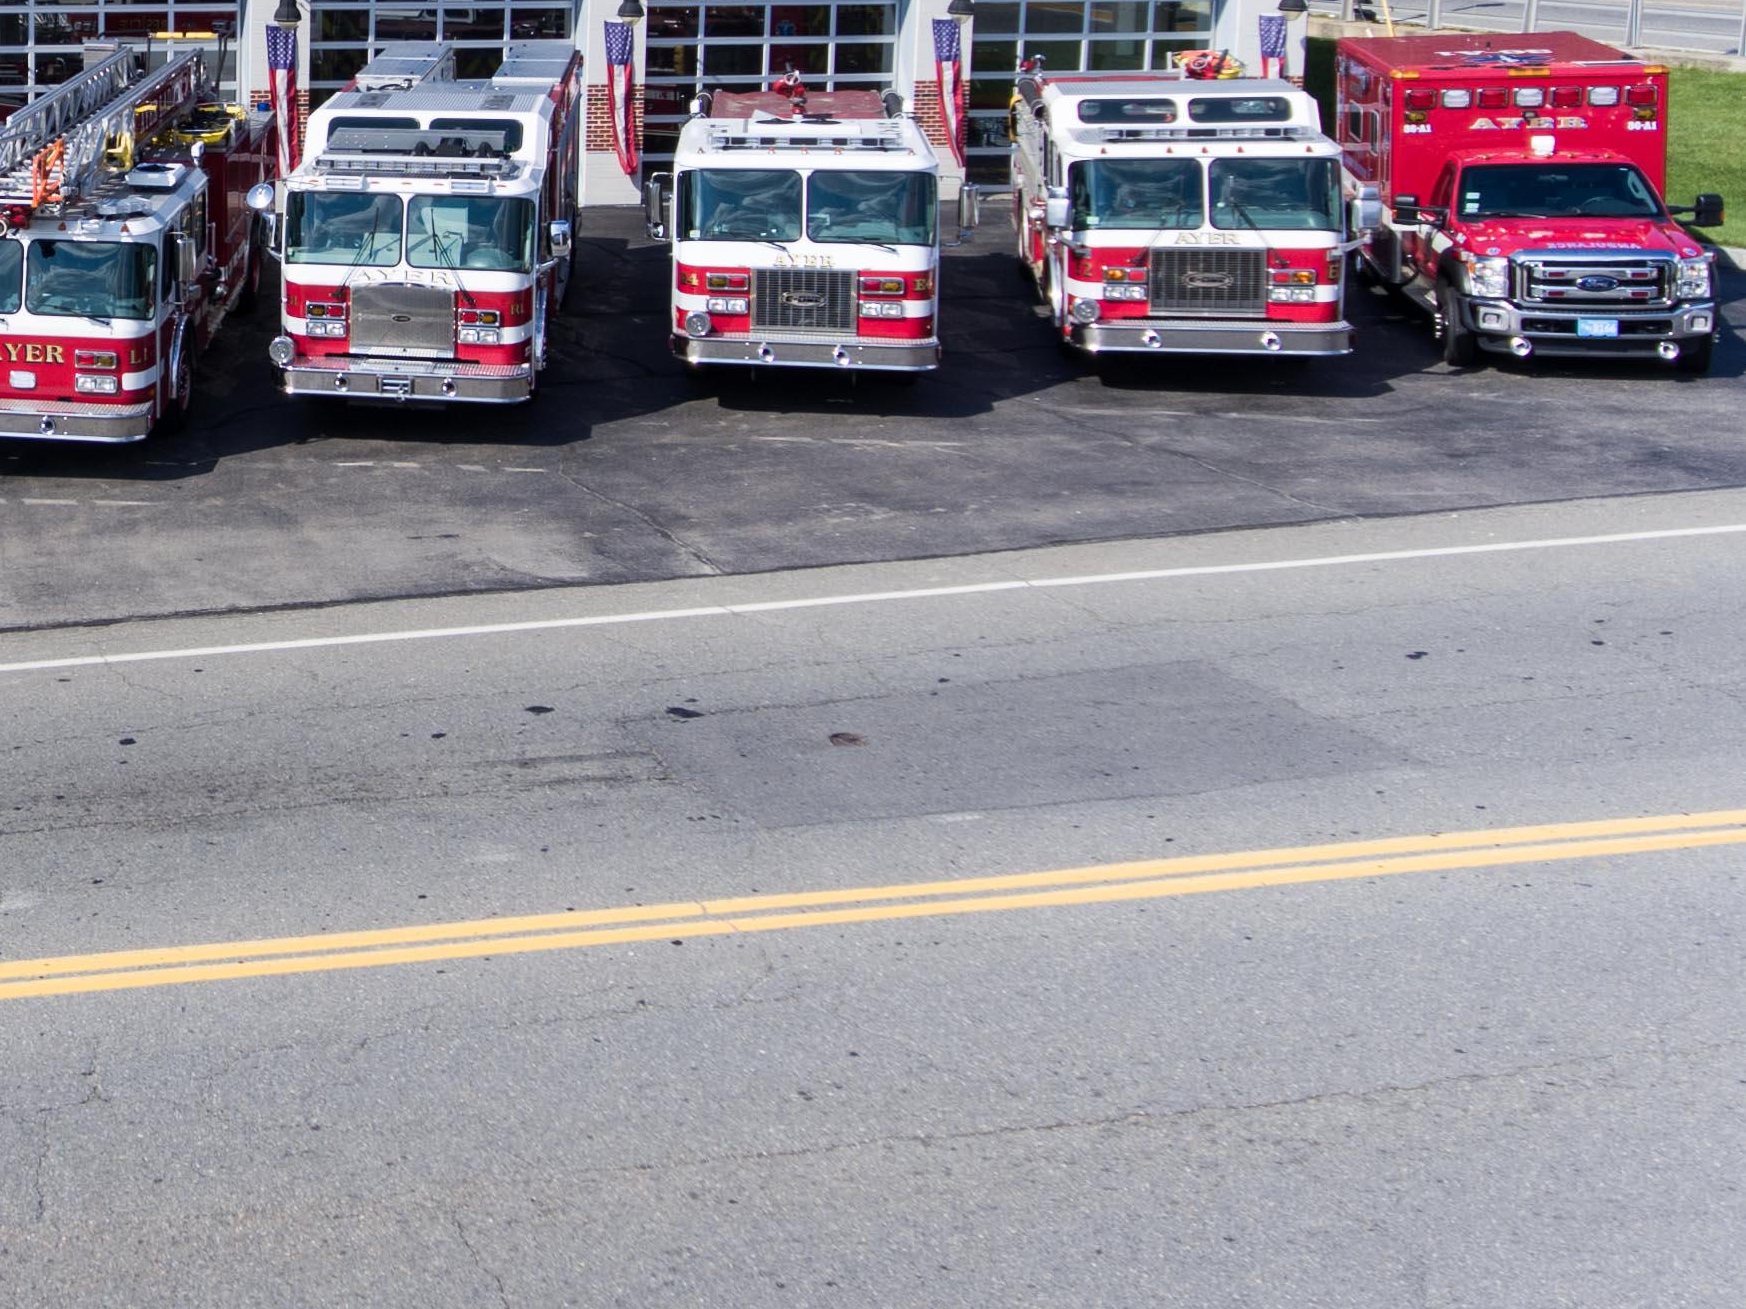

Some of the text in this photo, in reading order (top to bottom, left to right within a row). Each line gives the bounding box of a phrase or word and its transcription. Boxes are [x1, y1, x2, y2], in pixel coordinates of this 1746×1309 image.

[1469, 117, 1588, 129] AYER
[1175, 232, 1240, 245] AYER
[773, 255, 835, 268] AYER
[355, 269, 453, 285] AYER
